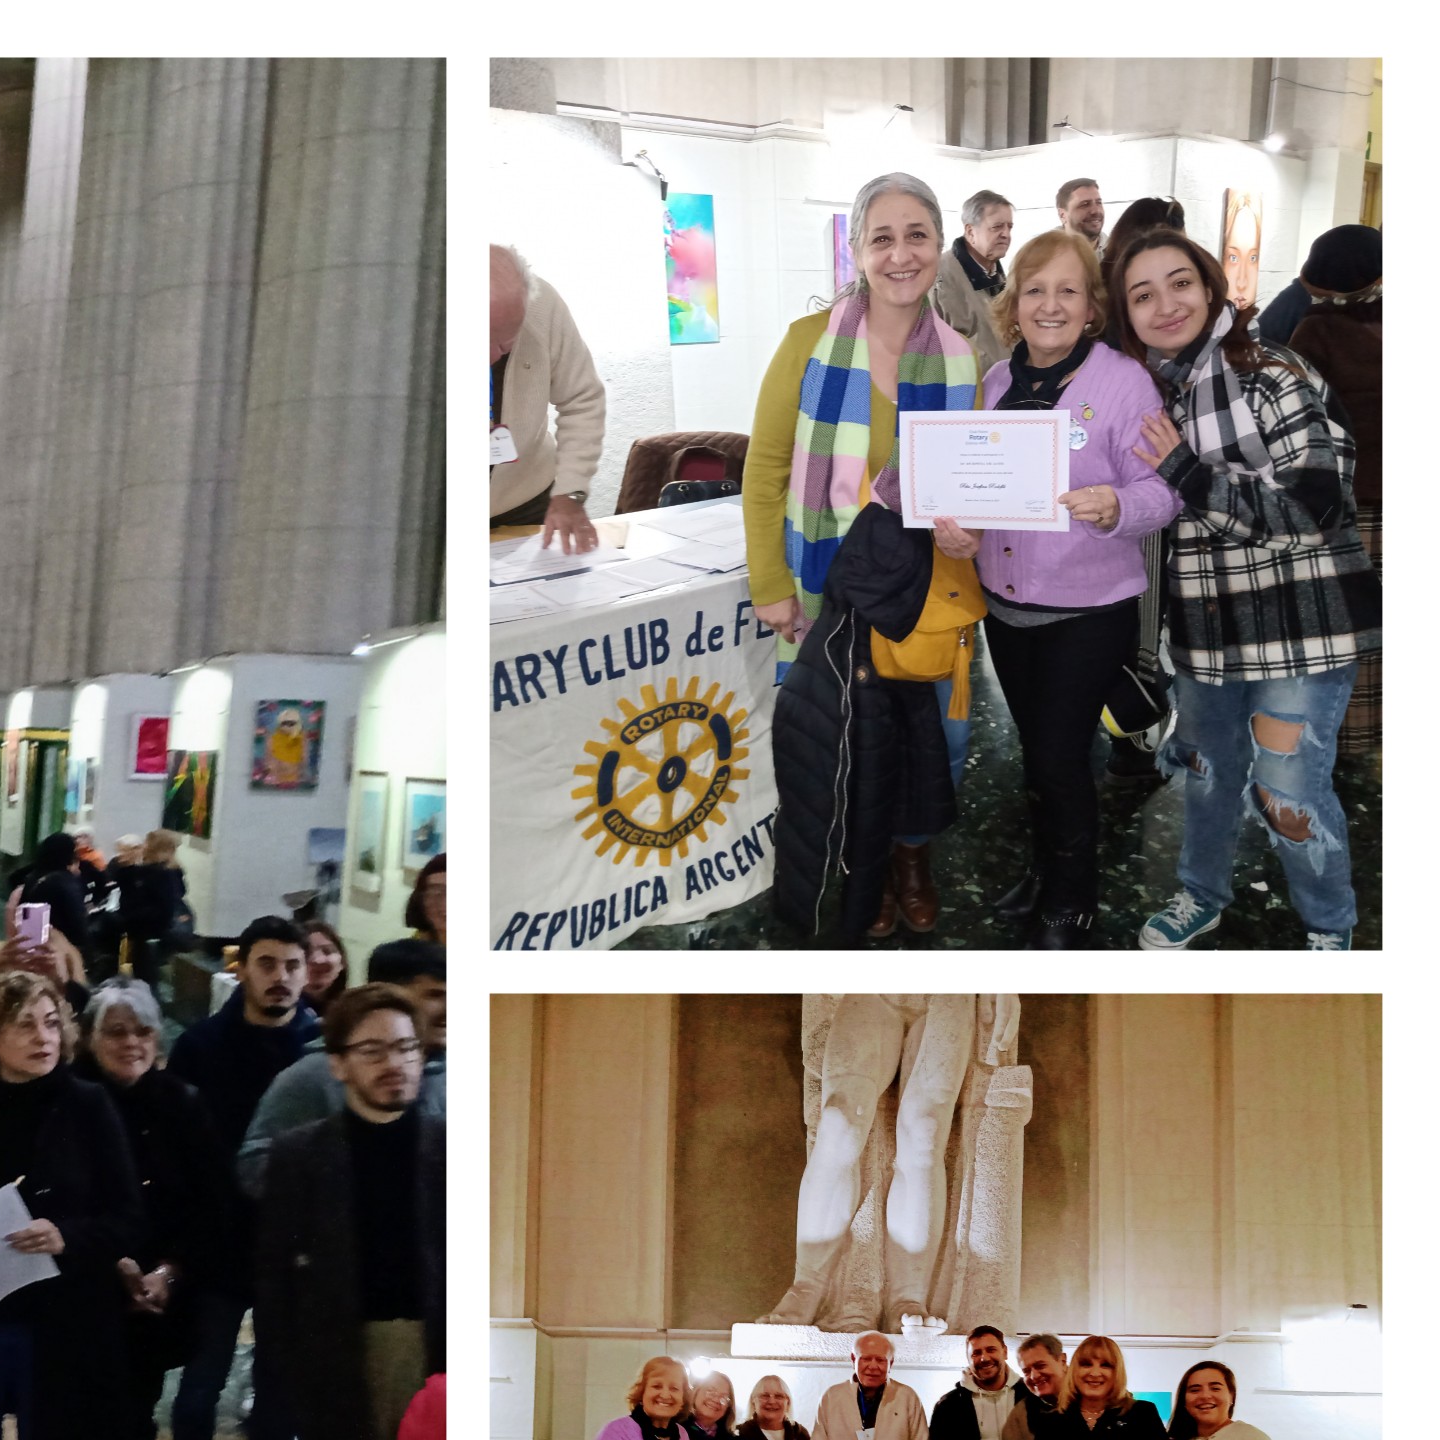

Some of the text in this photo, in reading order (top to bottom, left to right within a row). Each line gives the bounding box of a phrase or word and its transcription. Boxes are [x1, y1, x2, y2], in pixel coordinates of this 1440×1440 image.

[578, 617, 670, 686] CLUB
[685, 611, 724, 656] de
[625, 702, 707, 739] ROTARY
[608, 771, 729, 847] INTERNATIONAL
[493, 806, 779, 951] REPUBLICA ARGENT
